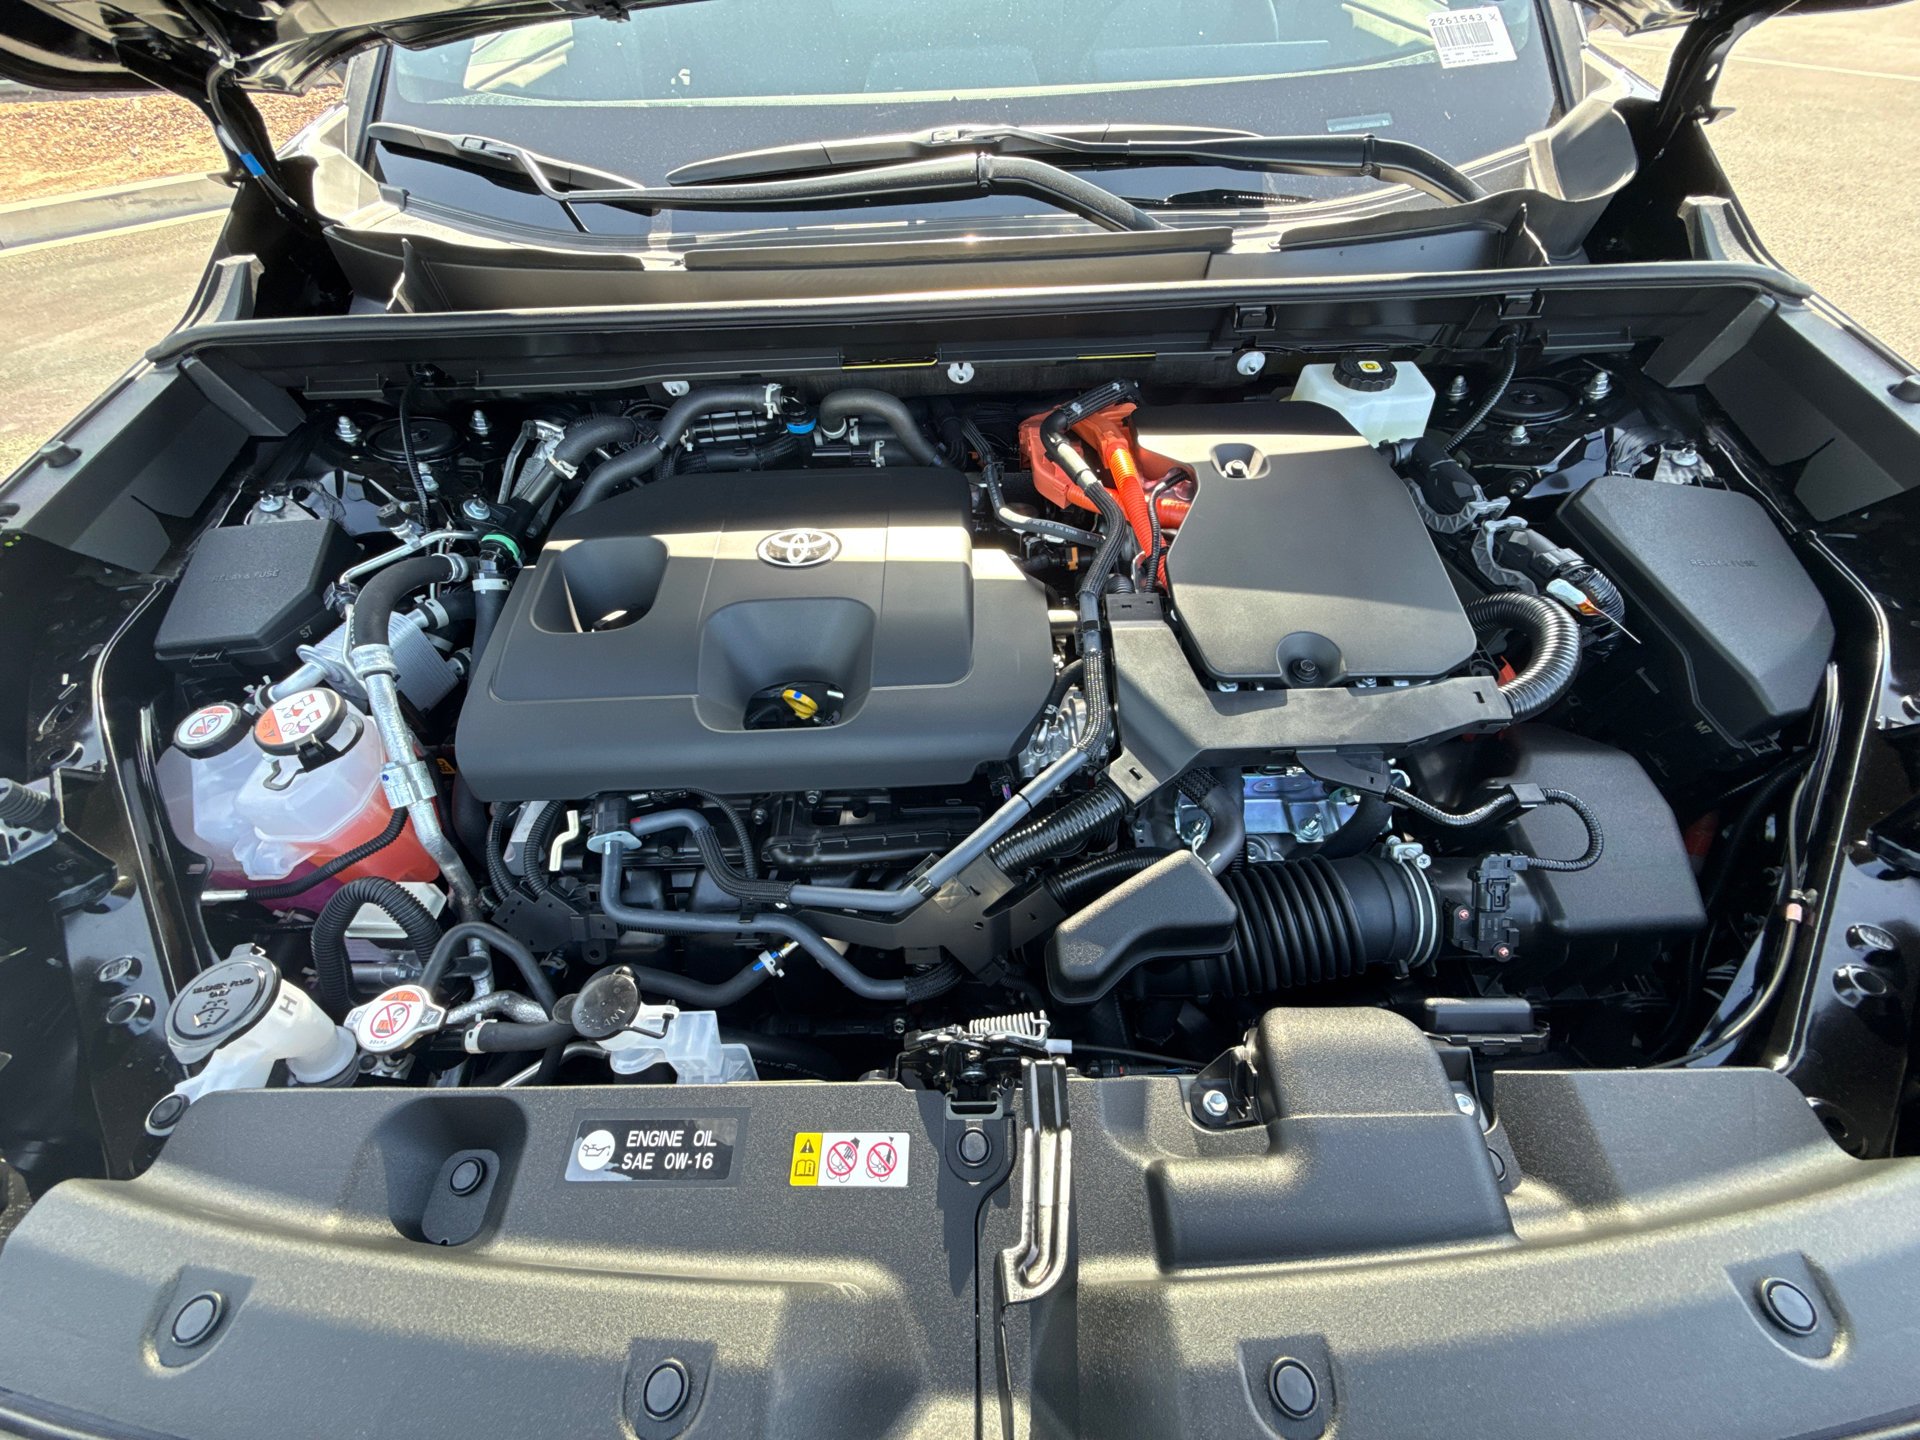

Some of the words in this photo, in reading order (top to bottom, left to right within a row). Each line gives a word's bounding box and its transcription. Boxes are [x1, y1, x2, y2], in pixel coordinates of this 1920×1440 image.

[1429, 13, 1483, 26] 2261543
[300, 625, 313, 638] S7
[626, 1130, 684, 1147] ENGINE
[693, 1130, 717, 1147] OIL
[621, 1152, 655, 1170] SAE
[664, 1152, 714, 1170] 0W-16
